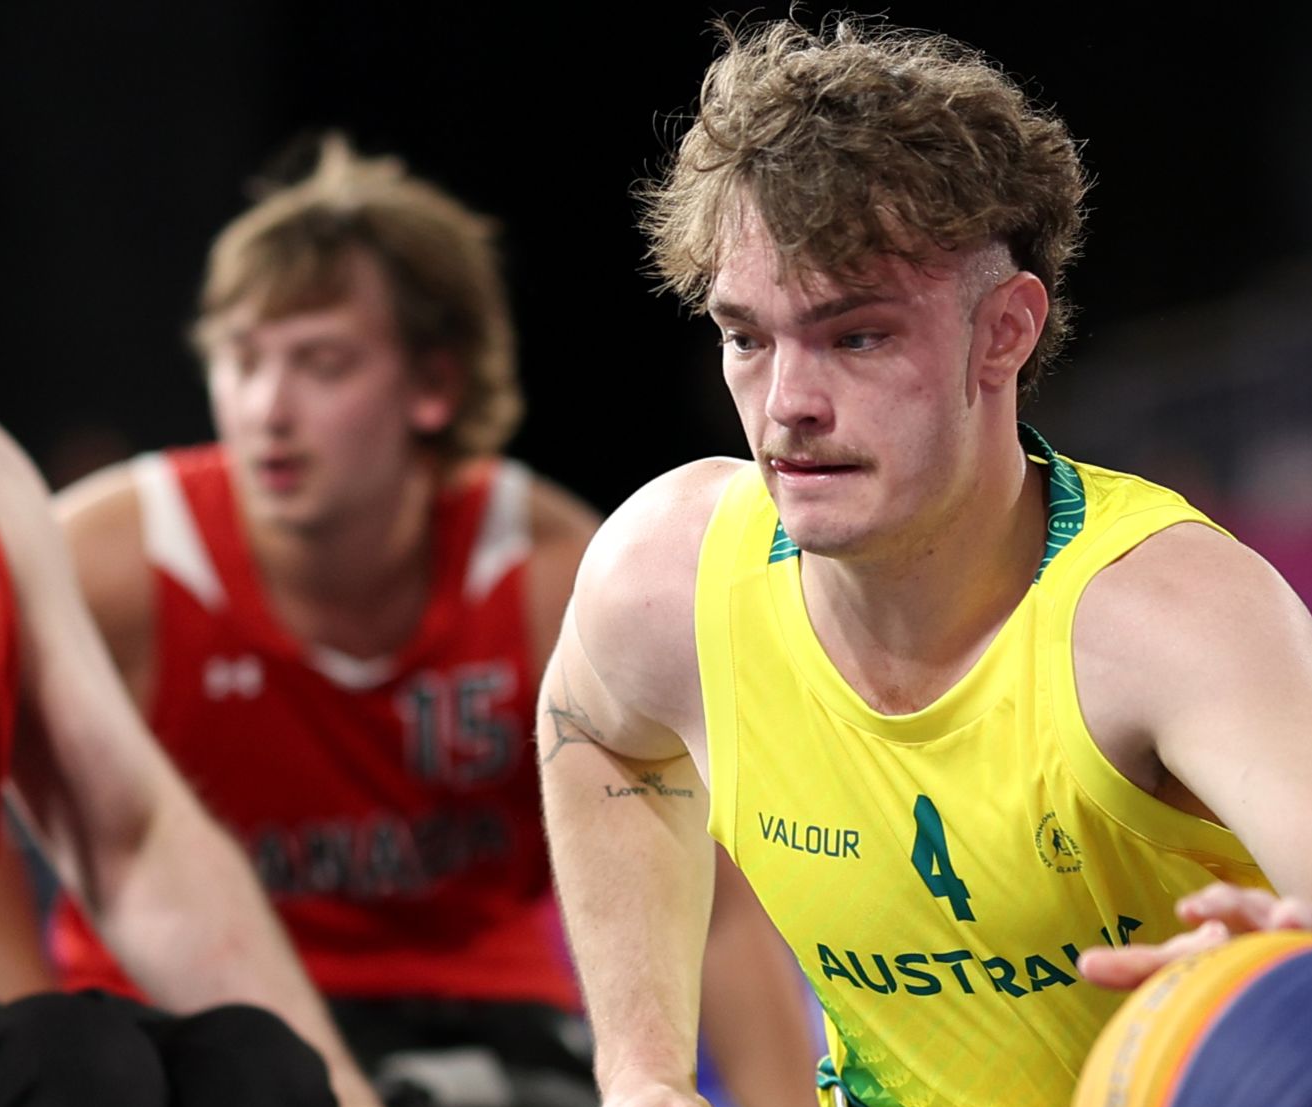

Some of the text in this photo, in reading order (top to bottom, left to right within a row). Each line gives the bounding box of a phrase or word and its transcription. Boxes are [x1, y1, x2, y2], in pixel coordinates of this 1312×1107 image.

[393, 660, 523, 788] 15
[604, 784, 649, 798] Love
[758, 811, 861, 860] VALOUR
[911, 794, 977, 922] 4
